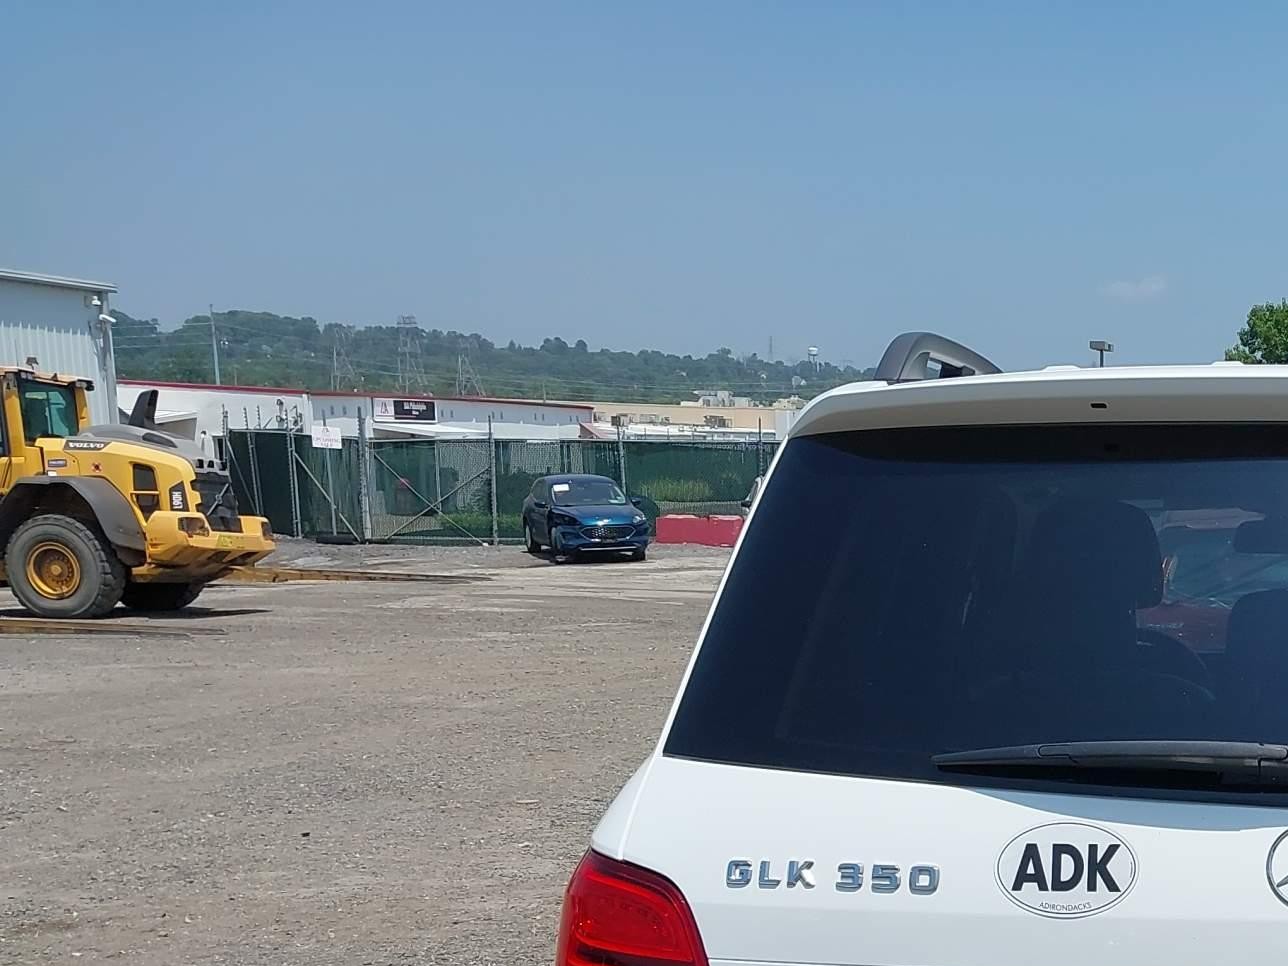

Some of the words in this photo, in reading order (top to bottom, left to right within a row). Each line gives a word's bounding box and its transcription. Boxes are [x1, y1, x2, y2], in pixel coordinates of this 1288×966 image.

[725, 859, 817, 889] GLK
[835, 861, 941, 896] 350
[1011, 842, 1122, 893] ADK
[1039, 901, 1093, 912] ADIRONDACKS
